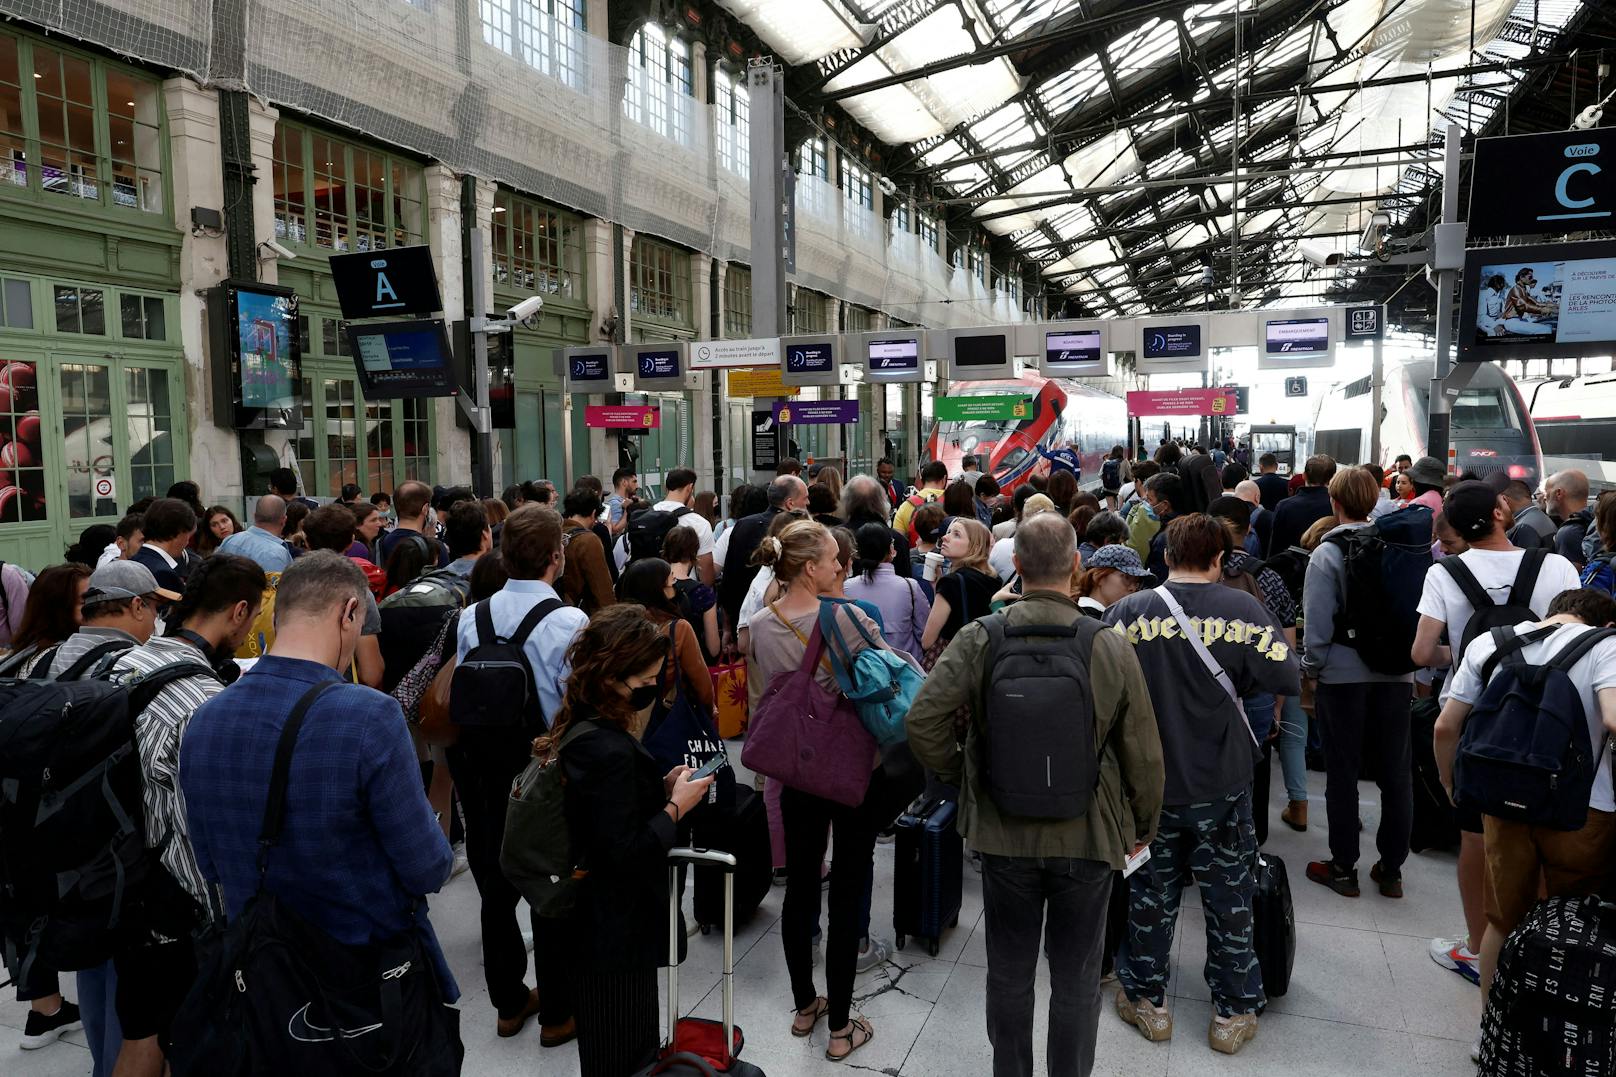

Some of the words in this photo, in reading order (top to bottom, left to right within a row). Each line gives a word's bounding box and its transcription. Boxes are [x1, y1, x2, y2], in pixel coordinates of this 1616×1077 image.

[1569, 146, 1594, 156] Voie
[1555, 162, 1602, 208] C
[376, 271, 398, 302] A
[1549, 946, 1566, 971] LAX
[1587, 984, 1605, 1009] ZRH
